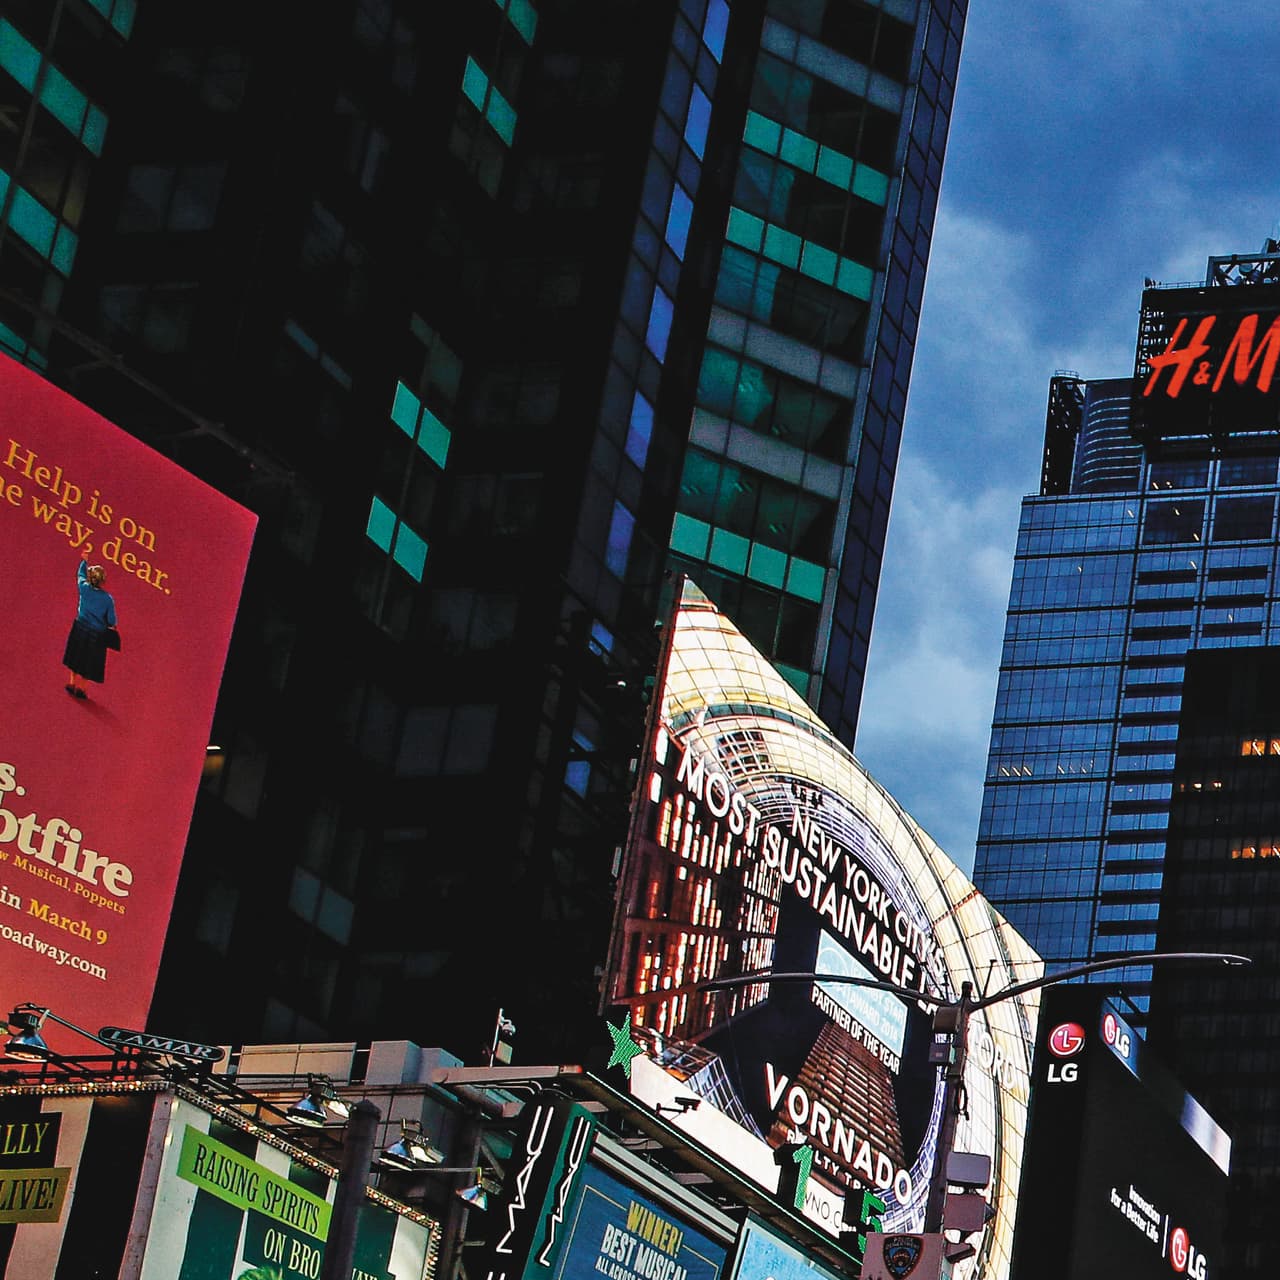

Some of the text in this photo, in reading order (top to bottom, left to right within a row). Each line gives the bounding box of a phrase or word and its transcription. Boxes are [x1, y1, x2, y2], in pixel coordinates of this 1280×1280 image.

[4, 438, 82, 509] Help
[88, 489, 113, 526] is
[119, 517, 156, 552] on
[32, 496, 171, 595] way, dear.
[677, 741, 915, 988] MOST SUSTAINABLE
[792, 807, 891, 928] NEW YORK
[26, 898, 108, 945] March 9
[109, 1030, 212, 1059] LAMAR
[811, 986, 900, 1075] PARTNER OF YEAR
[1047, 1063, 1078, 1083] LG
[764, 1062, 913, 1206] VORNADO
[194, 1143, 321, 1235] RAISING SPIRITS
[263, 1228, 285, 1262] ON
[595, 1256, 610, 1276] ALL
[601, 1224, 637, 1266] BEST
[626, 1200, 683, 1259] WINNER!
